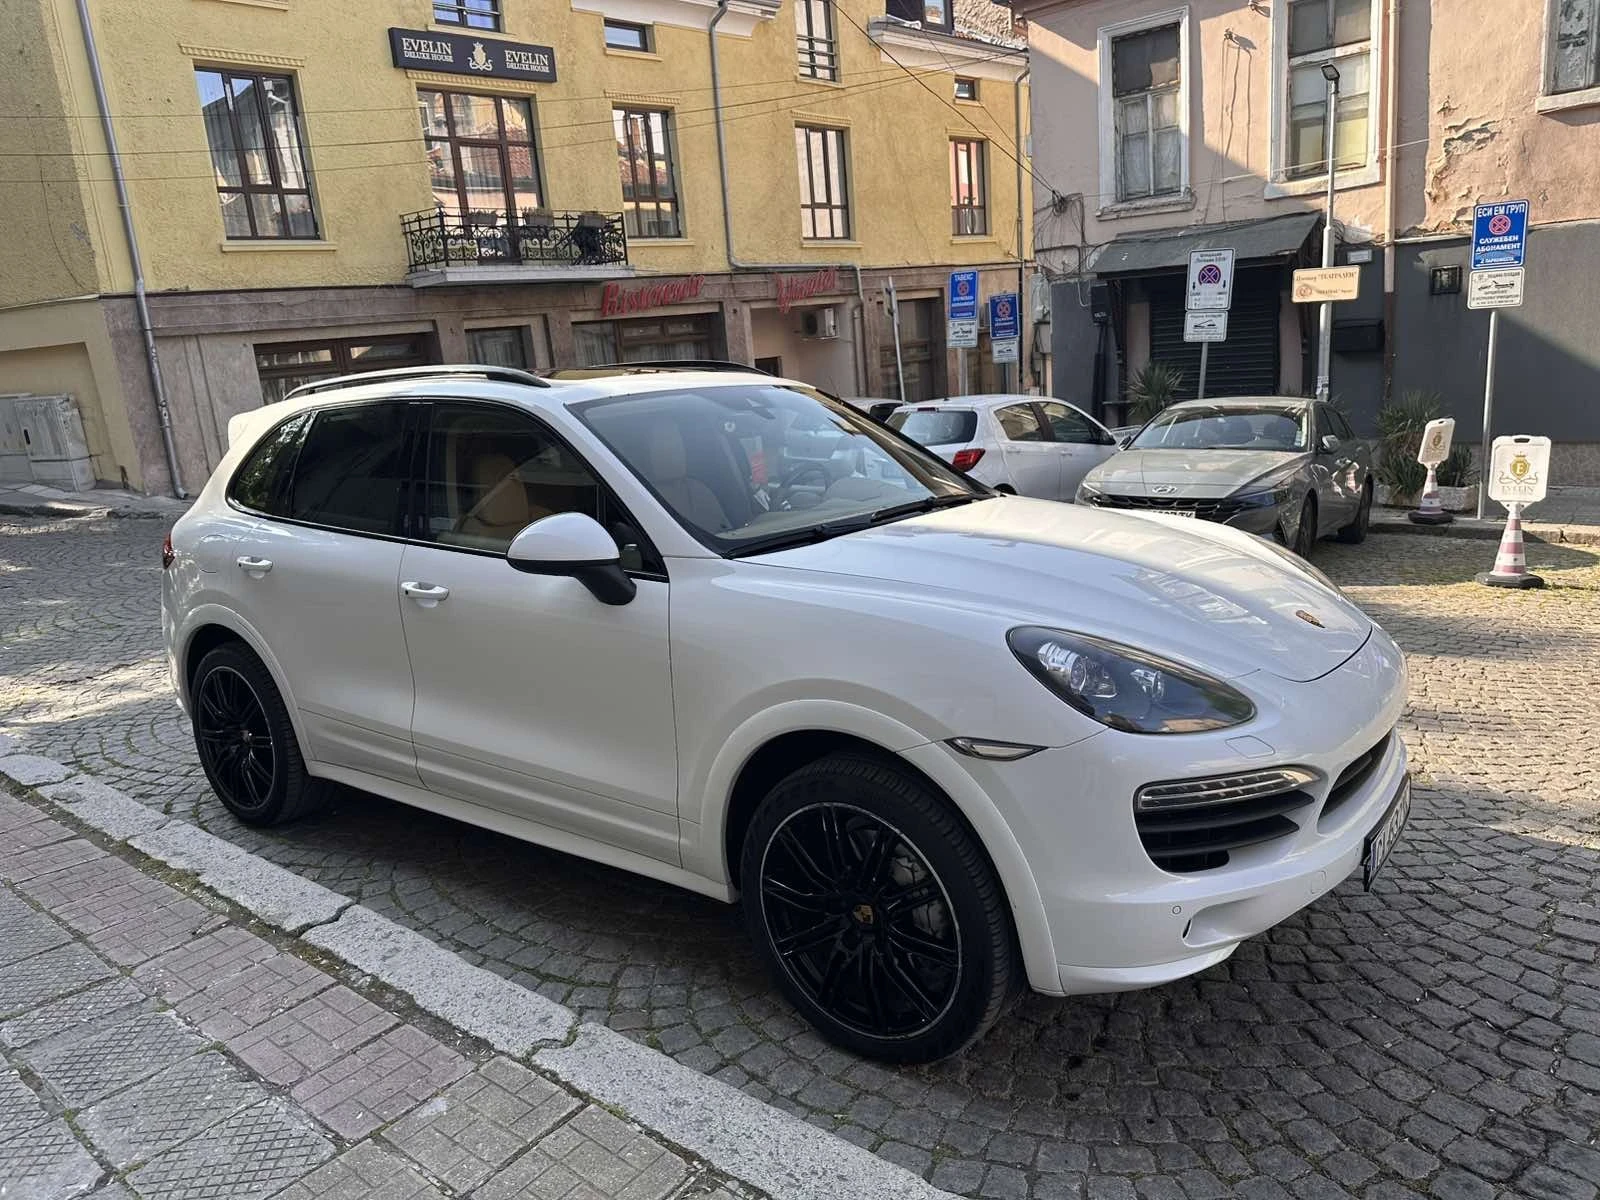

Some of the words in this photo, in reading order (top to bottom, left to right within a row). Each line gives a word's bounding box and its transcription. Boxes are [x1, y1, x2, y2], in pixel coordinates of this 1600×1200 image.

[402, 37, 452, 55] EVELIN
[403, 50, 430, 60] DELUXE
[431, 53, 454, 63] HOUSE
[505, 50, 549, 66] EVELIN
[506, 62, 530, 71] DELUXE
[530, 64, 550, 73] HOUSE
[1477, 207, 1493, 218] ЕСИ
[1493, 205, 1505, 216] ЕМ
[1506, 203, 1525, 215] ГРУП
[1479, 235, 1519, 245] СЛУЖЕБЕН
[1475, 243, 1521, 253] АБОНАМЕНТ
[1516, 462, 1525, 474] E
